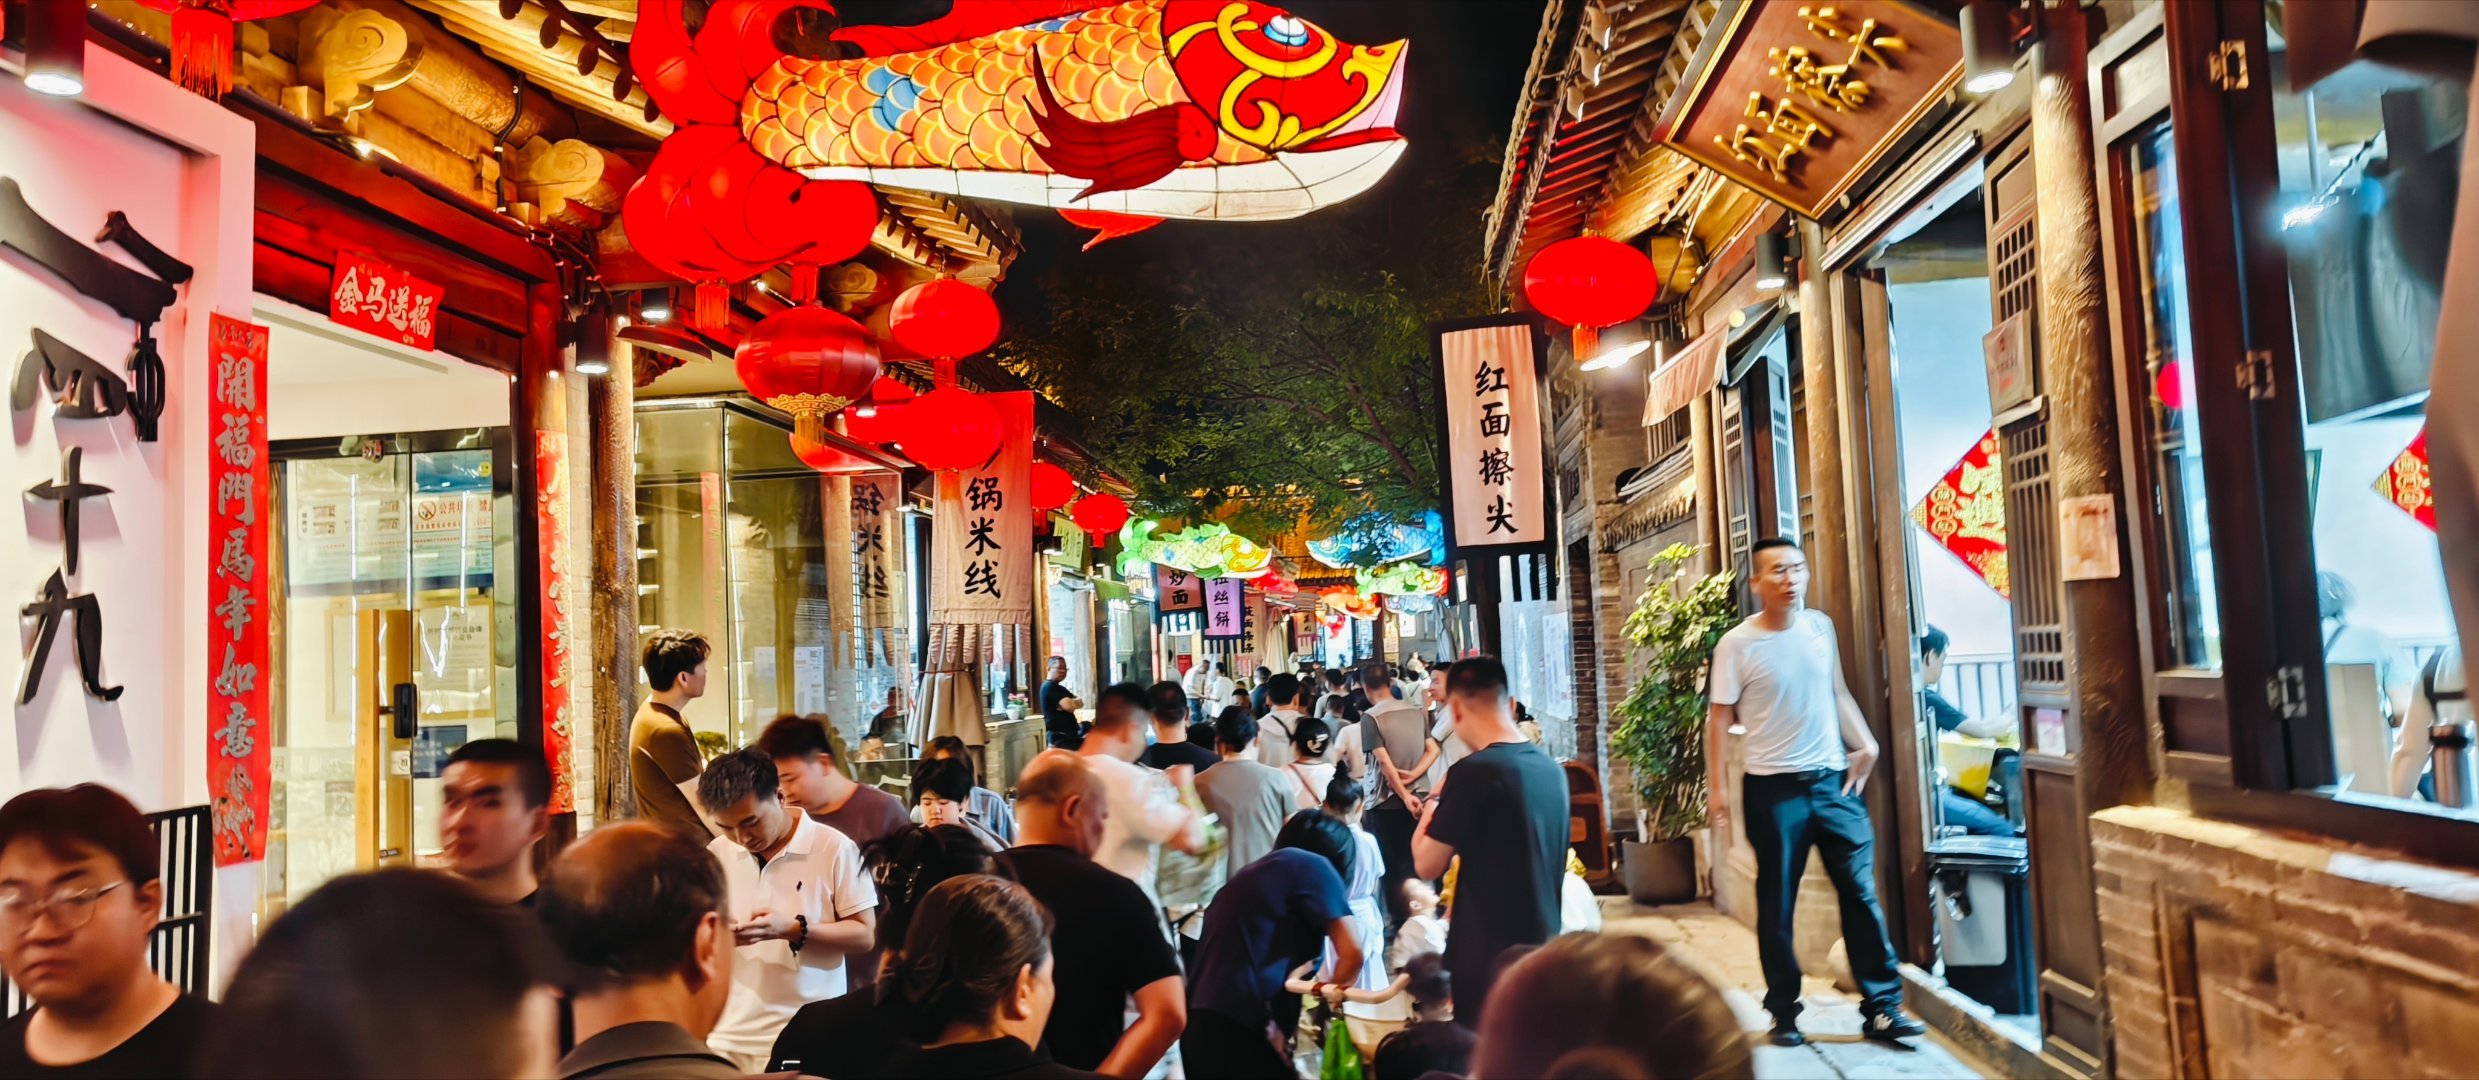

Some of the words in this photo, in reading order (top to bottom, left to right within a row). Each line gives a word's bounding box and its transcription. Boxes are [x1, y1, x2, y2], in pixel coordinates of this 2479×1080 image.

[334, 265, 433, 338] 金马送福
[964, 446, 1004, 600] 锅米线
[1474, 360, 1519, 535] 红面擦尖
